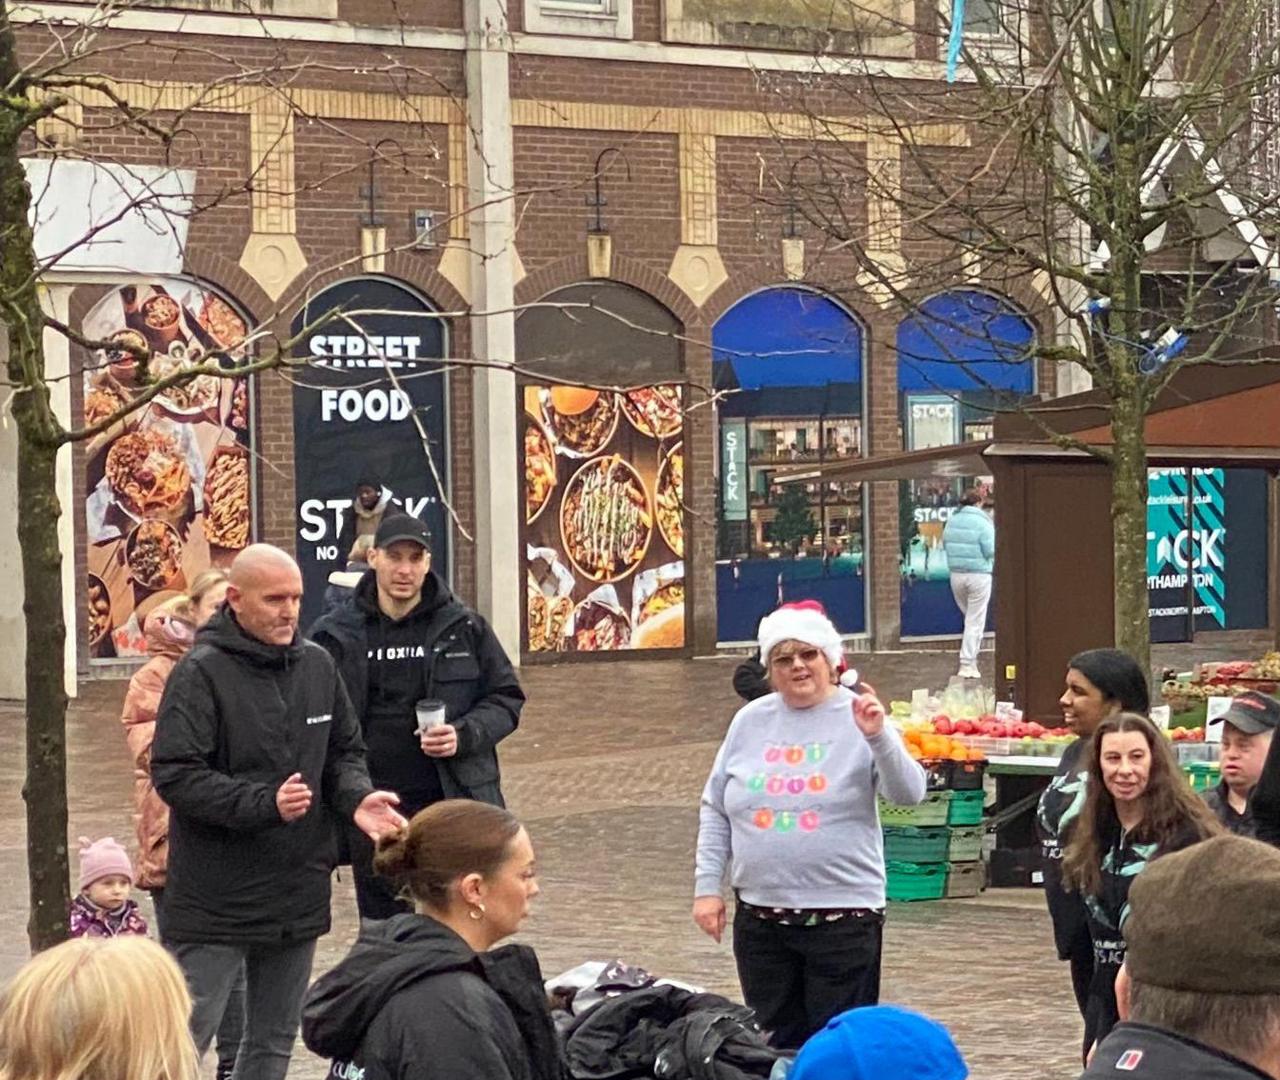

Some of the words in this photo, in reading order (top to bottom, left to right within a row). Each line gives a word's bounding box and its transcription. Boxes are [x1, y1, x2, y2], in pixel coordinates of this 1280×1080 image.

[310, 335, 420, 368] STREET
[321, 388, 410, 421] FOOD
[316, 546, 338, 560] NO
